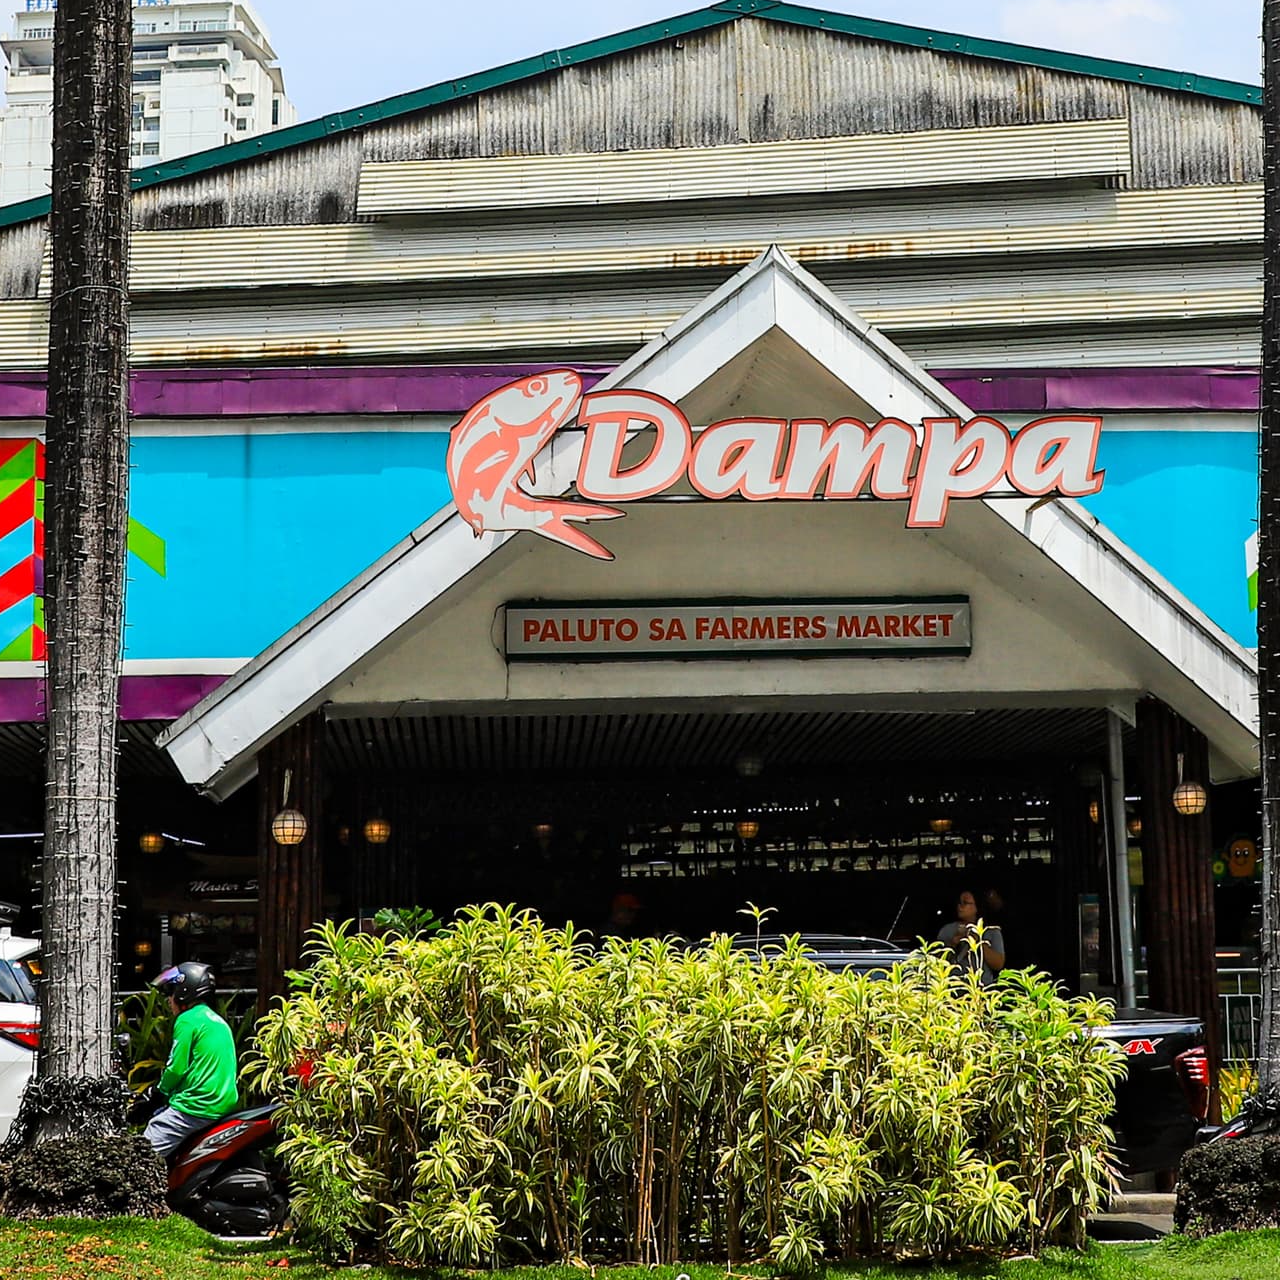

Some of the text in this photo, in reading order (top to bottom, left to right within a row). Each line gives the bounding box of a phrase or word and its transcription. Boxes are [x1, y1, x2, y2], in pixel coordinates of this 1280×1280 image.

[575, 387, 1106, 529] Dampa
[523, 614, 954, 642] PALUTO SA FARMERS MARKET
[188, 880, 240, 893] Master
